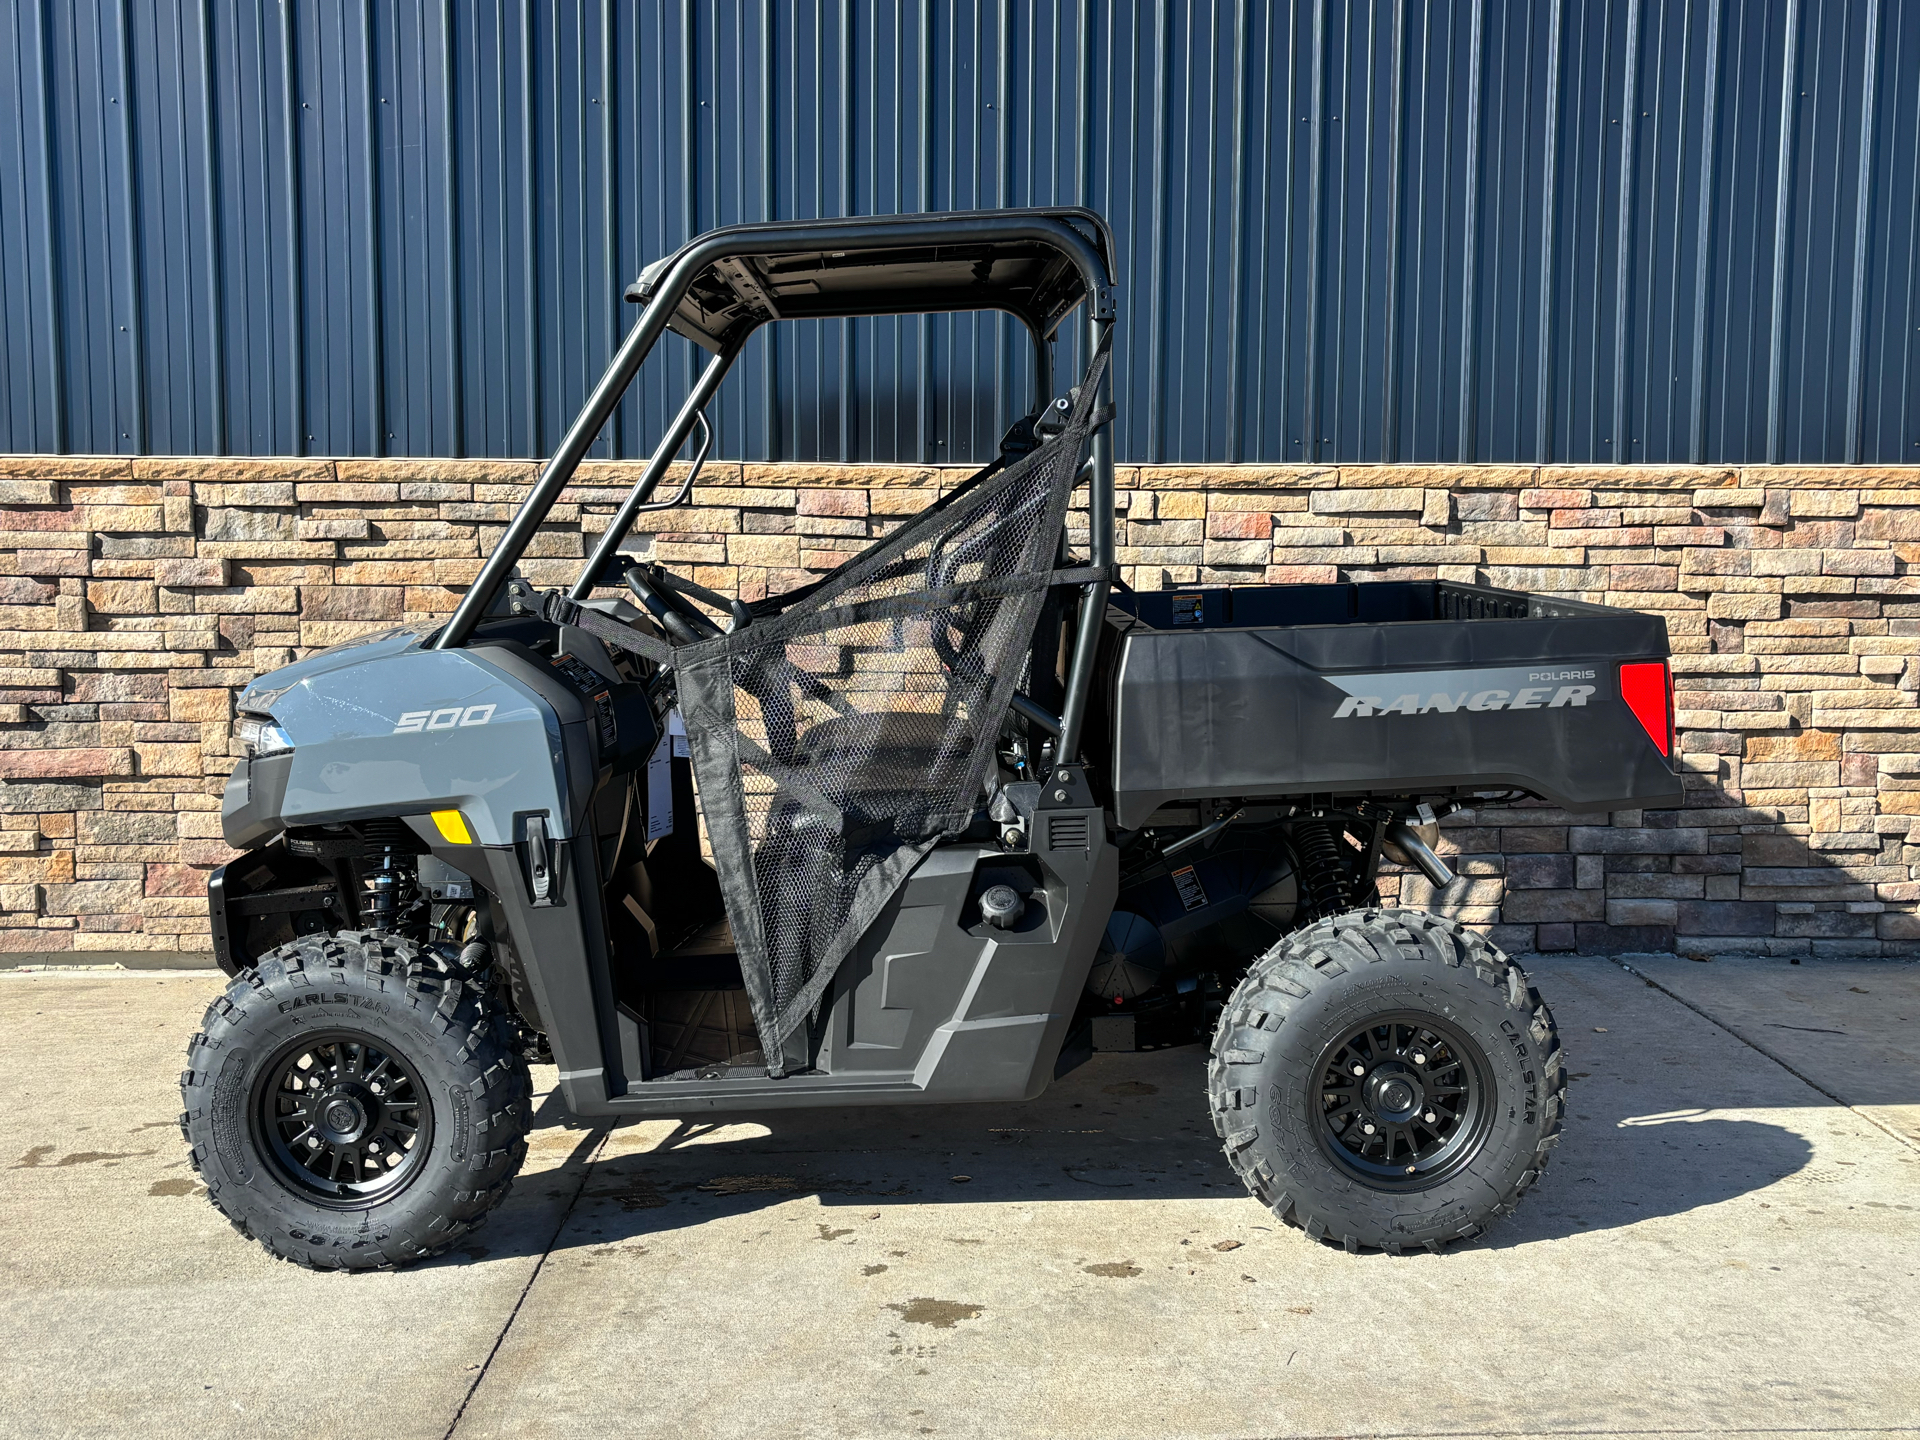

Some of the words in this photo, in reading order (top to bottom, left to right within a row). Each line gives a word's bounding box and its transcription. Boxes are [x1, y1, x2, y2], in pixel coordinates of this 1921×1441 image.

[1529, 670, 1596, 682] POLARIS
[1331, 685, 1596, 719] RANGER
[393, 704, 497, 734] 500
[277, 992, 391, 1016] CARLSTAR
[1499, 1018, 1537, 1125] CARLSTAR
